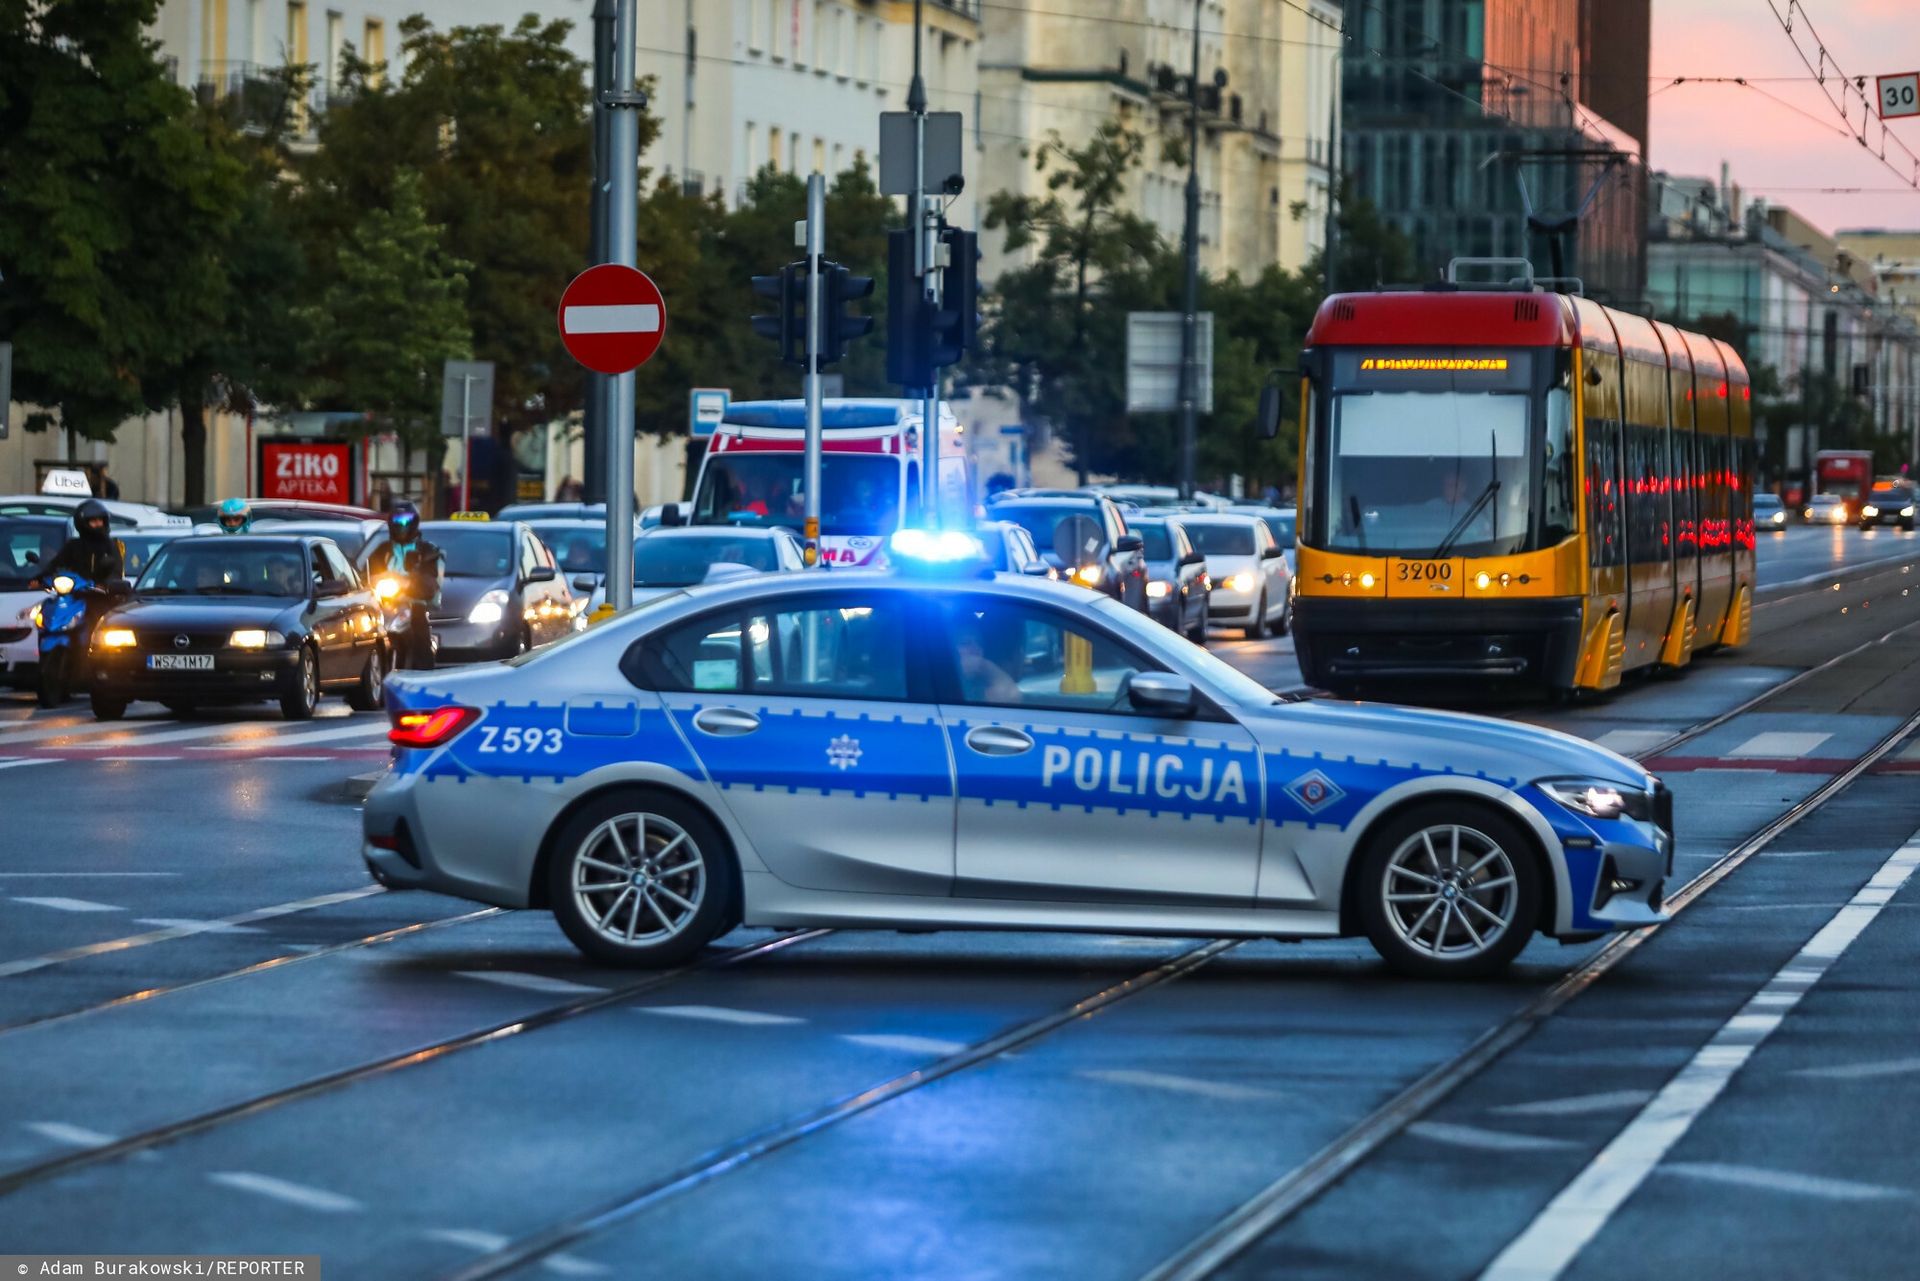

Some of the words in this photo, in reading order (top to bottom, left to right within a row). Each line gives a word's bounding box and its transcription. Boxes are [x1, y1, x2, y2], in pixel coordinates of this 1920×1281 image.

[1886, 86, 1914, 107] 30
[55, 475, 84, 488] Uber
[276, 480, 338, 496] APTEKA
[1397, 562, 1452, 580] 3200
[478, 726, 563, 754] Z593
[1042, 744, 1247, 804] POLICJA
